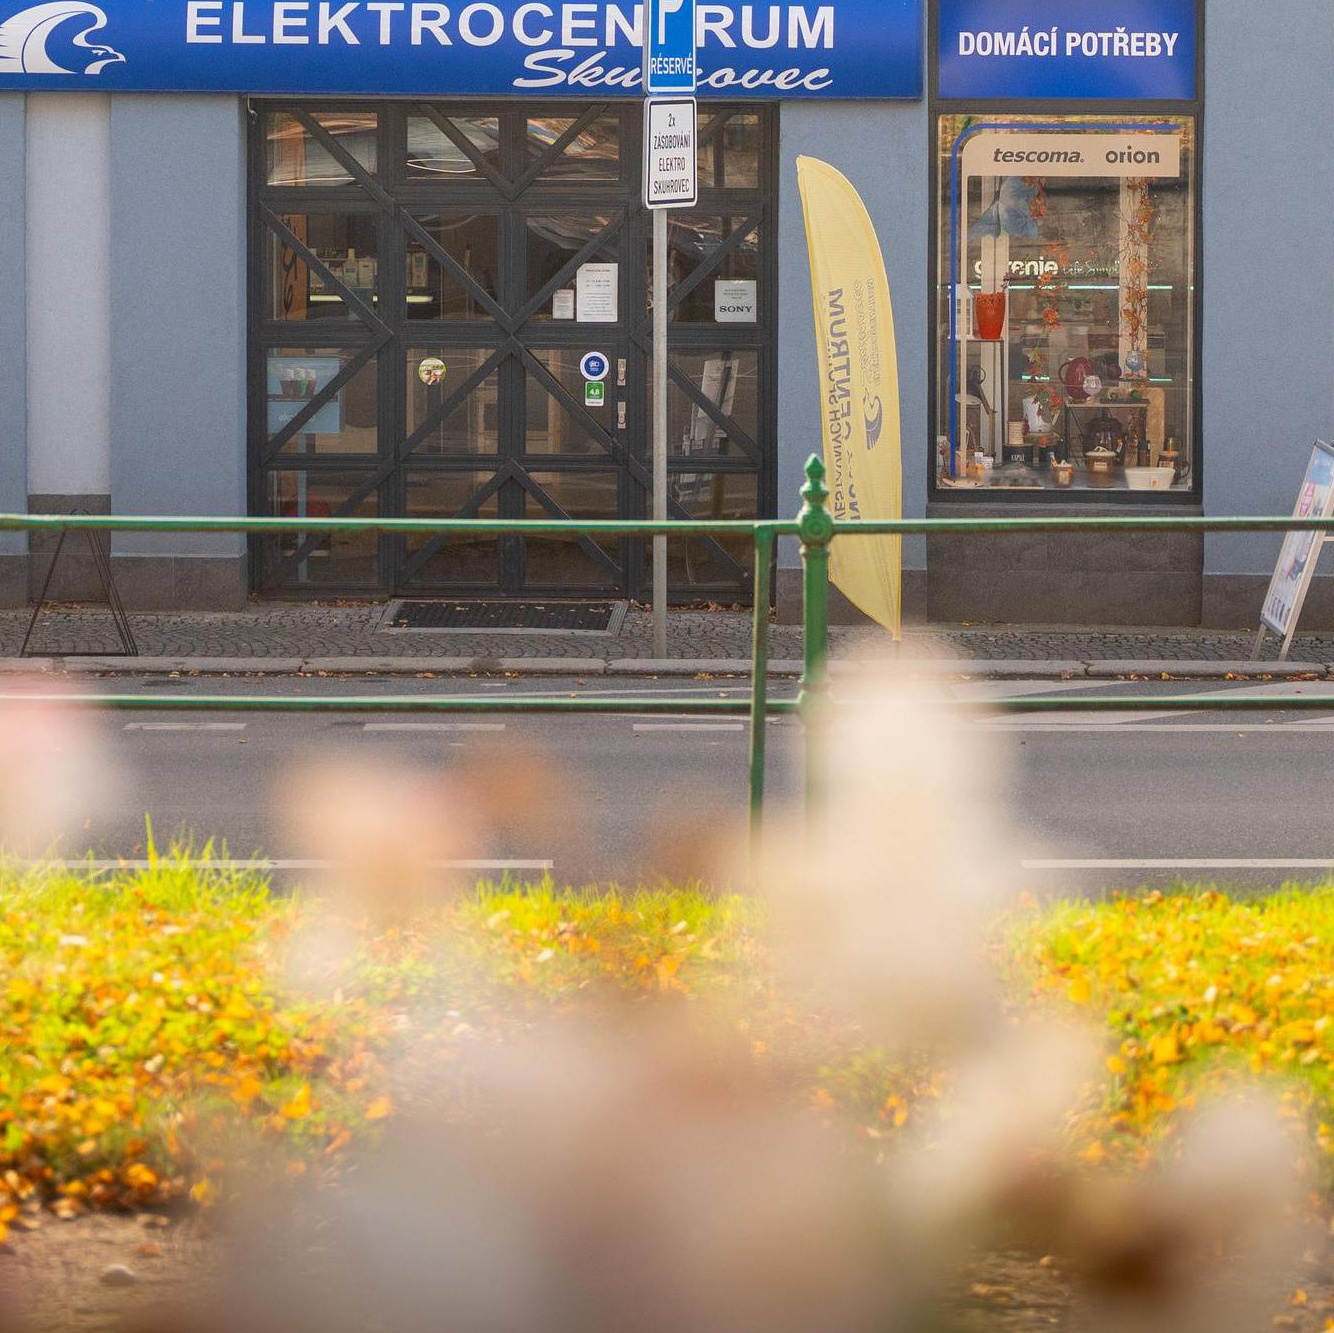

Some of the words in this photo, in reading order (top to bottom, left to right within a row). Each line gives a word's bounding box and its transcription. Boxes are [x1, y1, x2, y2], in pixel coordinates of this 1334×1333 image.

[186, 1, 834, 48] ELEKTROCENRUM
[958, 27, 1058, 56] DOMÁCÍ
[1066, 27, 1179, 57] POTŘEBY
[513, 49, 833, 91] Skuovec
[651, 53, 693, 75] RÉSERVÉ
[668, 113, 676, 127] 2x
[654, 131, 691, 149] ZÁSOBOVÁNÍ
[1105, 145, 1160, 164] orion
[659, 157, 686, 172] ELEKTRO
[654, 179, 690, 194] SKUHROVEC
[719, 305, 753, 313] SONY
